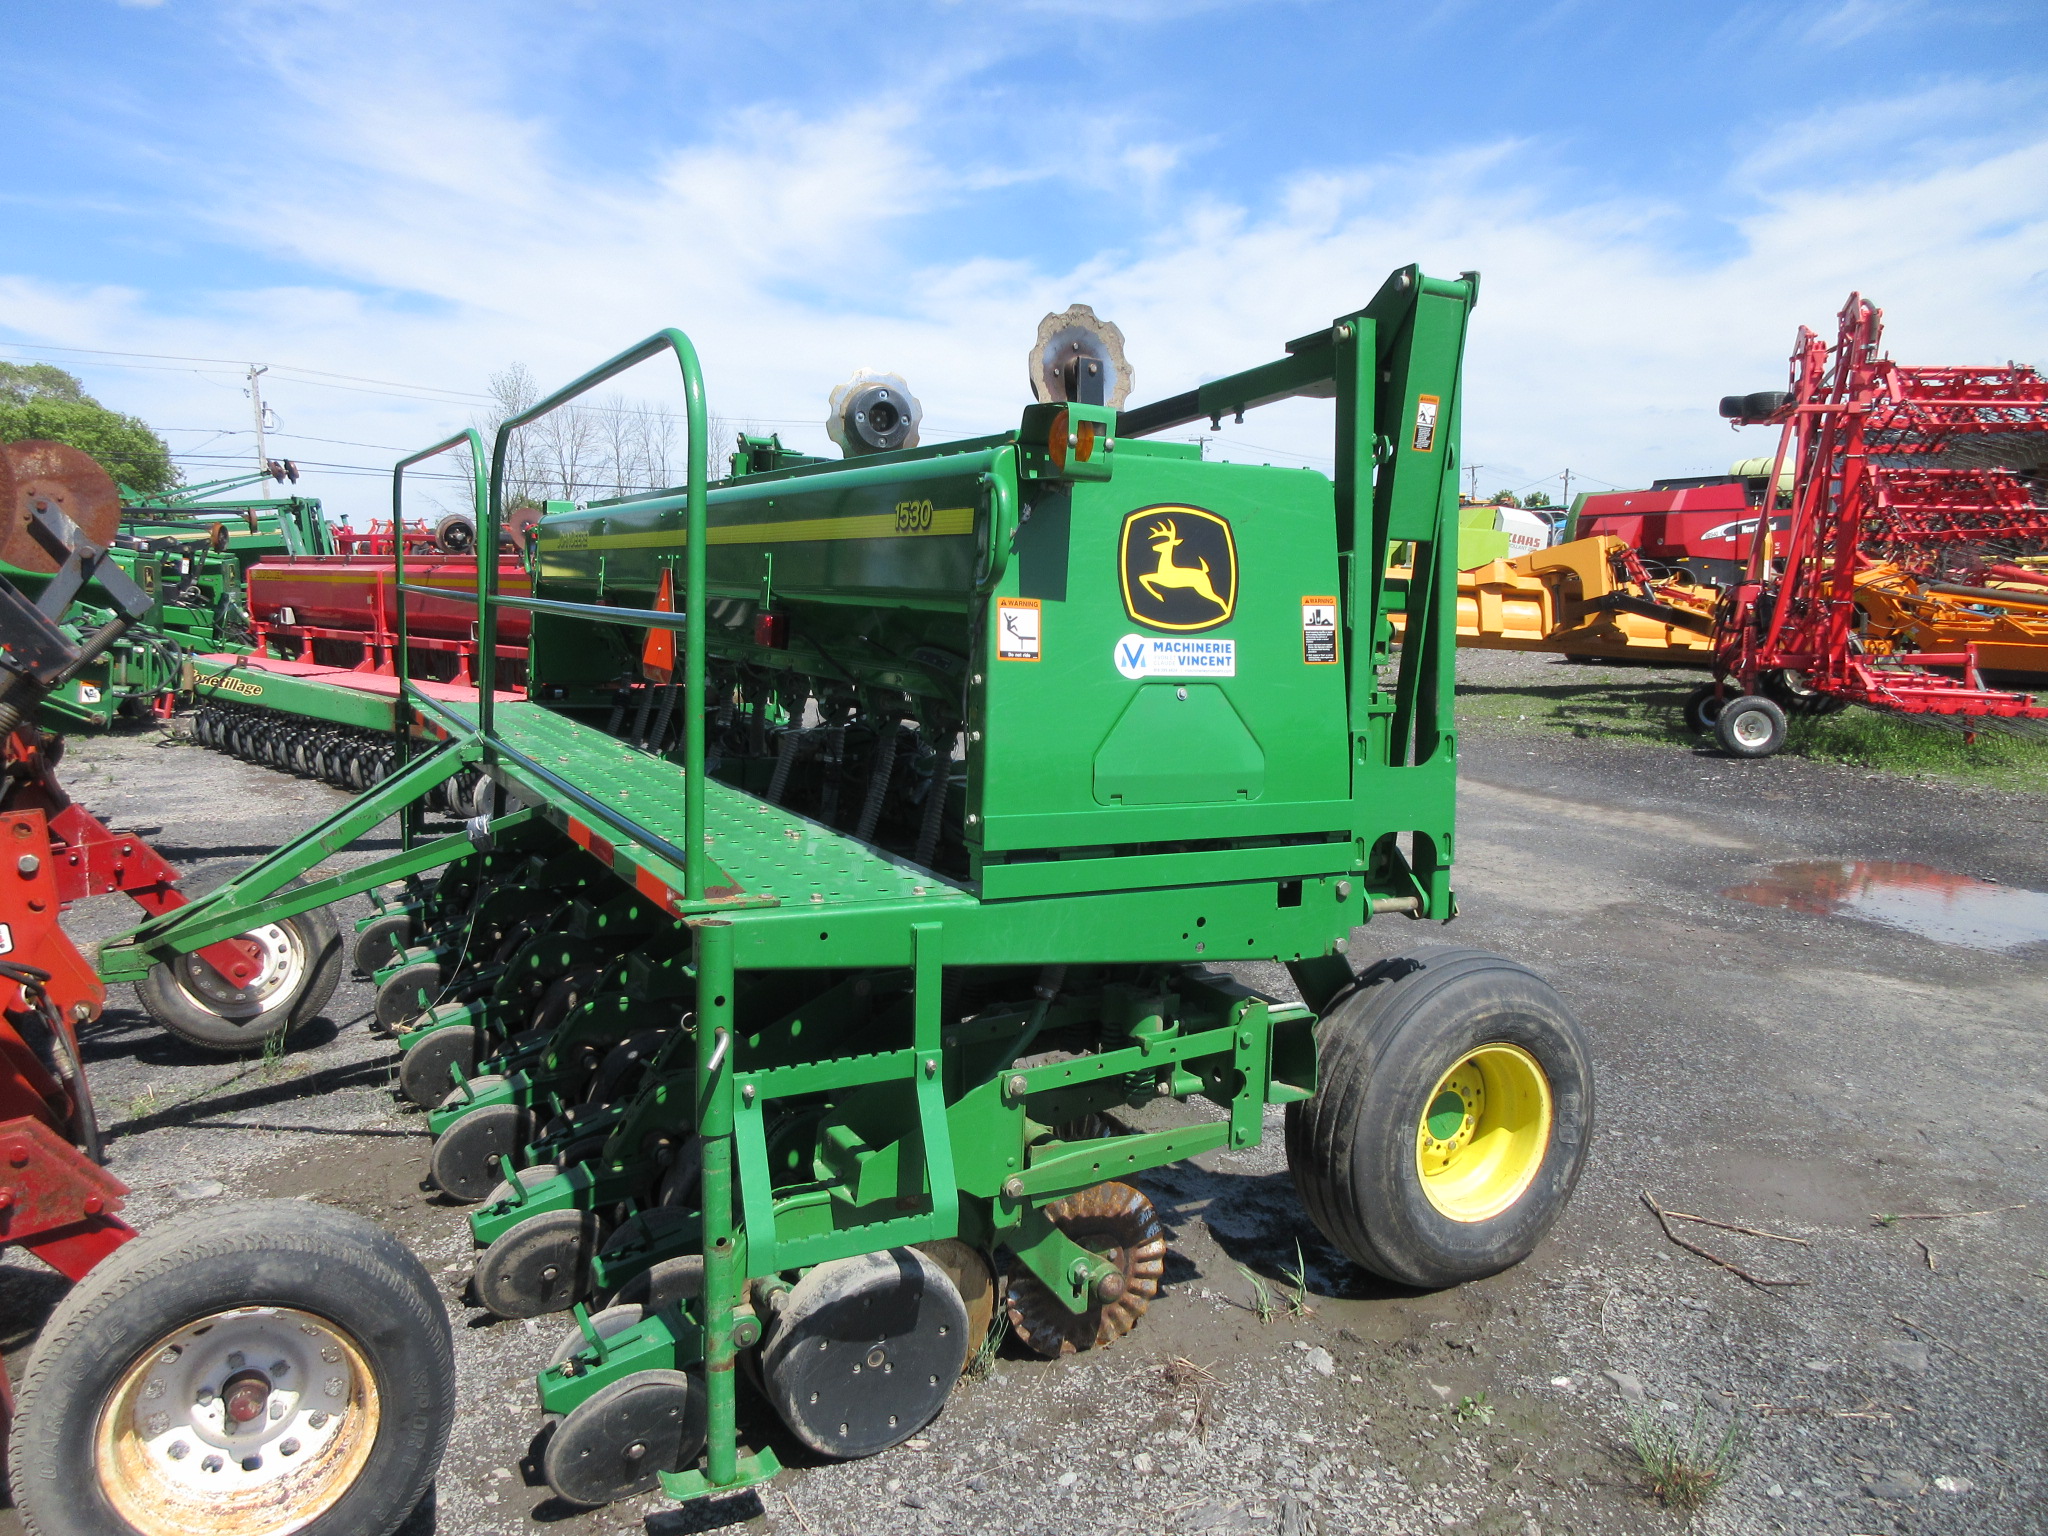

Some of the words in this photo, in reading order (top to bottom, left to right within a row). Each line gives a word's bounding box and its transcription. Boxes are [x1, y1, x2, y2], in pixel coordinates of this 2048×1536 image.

[895, 499, 932, 531] 1530
[1008, 600, 1038, 608] WARNING
[1153, 642, 1232, 653] MACHINERIE
[1178, 655, 1232, 666] VINCENT
[38, 1318, 128, 1480] CARLISLE
[401, 1369, 431, 1471] SPORT
